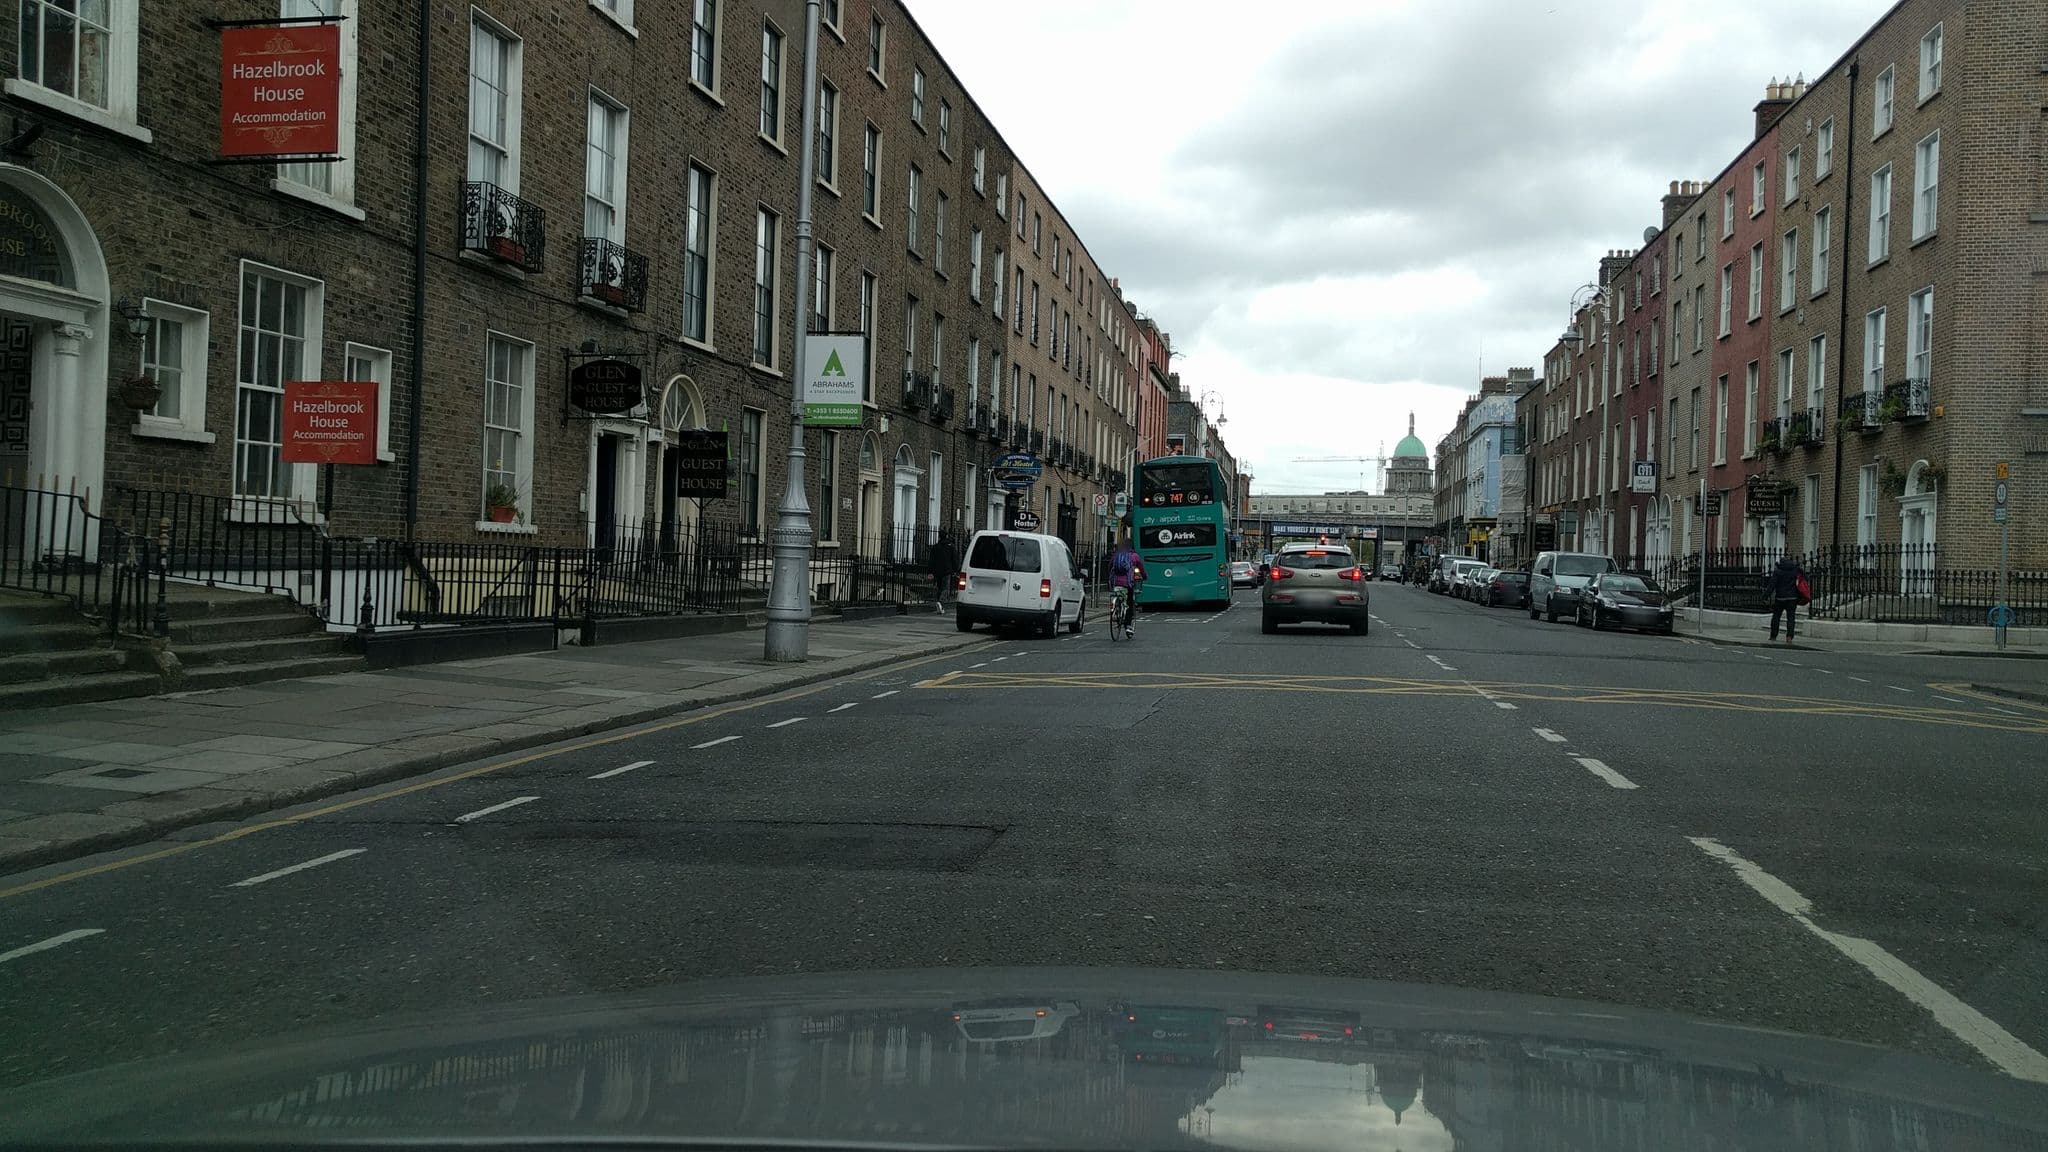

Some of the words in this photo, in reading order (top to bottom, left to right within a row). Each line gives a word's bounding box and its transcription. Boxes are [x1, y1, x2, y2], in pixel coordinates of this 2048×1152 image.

[232, 59, 325, 79] Hazelbrook
[254, 86, 305, 102] House
[232, 109, 326, 123] Accommodation
[585, 366, 627, 379] GLEN
[585, 382, 627, 393] GUEST
[293, 400, 364, 414] Hazelbrook
[585, 396, 625, 408] HOUSE
[310, 415, 349, 428] House
[292, 430, 364, 440] Accommodation
[681, 459, 724, 470] GUEST
[681, 479, 723, 489] HOUSE
[1169, 493, 1184, 503] 747
[1143, 516, 1155, 524] city
[1160, 515, 1181, 523] airport
[1173, 532, 1196, 540] Airlink
